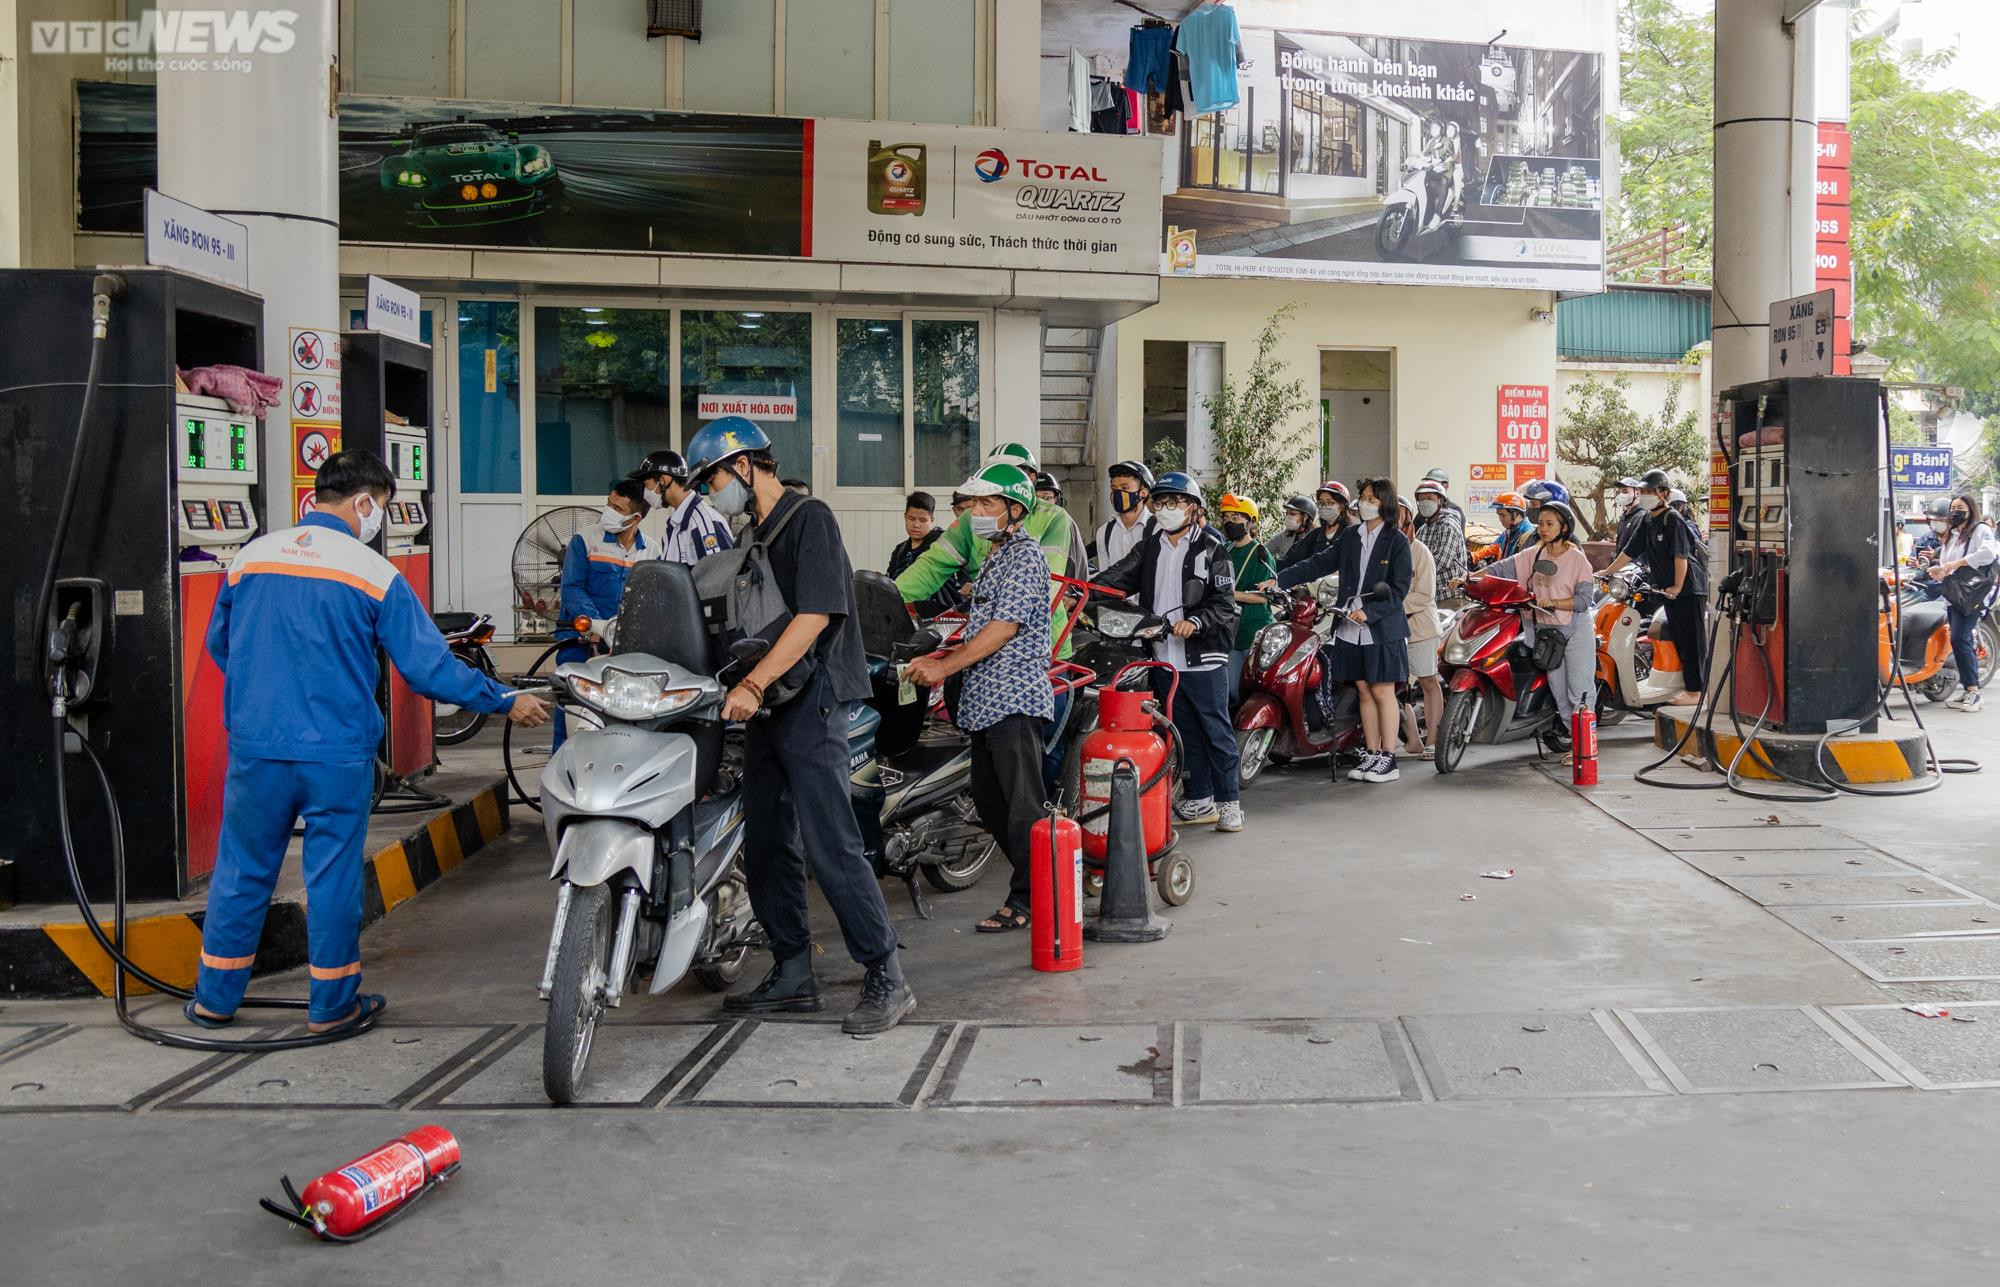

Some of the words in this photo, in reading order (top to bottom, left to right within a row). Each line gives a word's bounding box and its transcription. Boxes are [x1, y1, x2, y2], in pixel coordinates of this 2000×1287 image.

[1280, 50, 1323, 73] Đồng
[1328, 56, 1369, 74] hành
[1373, 58, 1403, 76] bên
[1408, 61, 1438, 81] bạn
[1281, 73, 1326, 96] trong
[1331, 78, 1368, 98] từng
[1373, 80, 1432, 100] khoảnh
[1436, 81, 1475, 102] khắc
[450, 172, 506, 183] TOTAL
[1016, 159, 1107, 182] TOTAL
[1015, 184, 1125, 212] QUARTZ
[1060, 214, 1086, 223] ĐỘNG
[163, 217, 190, 245] XĂNG
[191, 230, 210, 253] RON
[211, 238, 221, 256] 95
[867, 229, 901, 246] Động
[905, 232, 921, 244] cơ
[924, 235, 955, 247] sung
[959, 233, 986, 248] sức,
[990, 234, 1028, 249] Thách
[1032, 236, 1060, 250] thức
[1063, 238, 1088, 251] thời
[1091, 240, 1118, 254] gian
[1215, 263, 1233, 271] TOTAL
[1790, 300, 1814, 320] XĂNG
[1773, 327, 1787, 344] RON
[1815, 319, 1826, 335] E5
[701, 401, 719, 413] NƠI
[721, 399, 748, 414] XUẤT
[773, 403, 794, 415] ĐƠN
[1501, 400, 1520, 418] BẢO
[1522, 400, 1547, 418] HIỂM
[1506, 420, 1542, 440] ÔTÔ
[1500, 443, 1516, 459] XE
[1519, 441, 1548, 459] MÁY
[850, 751, 869, 767] MAHA
